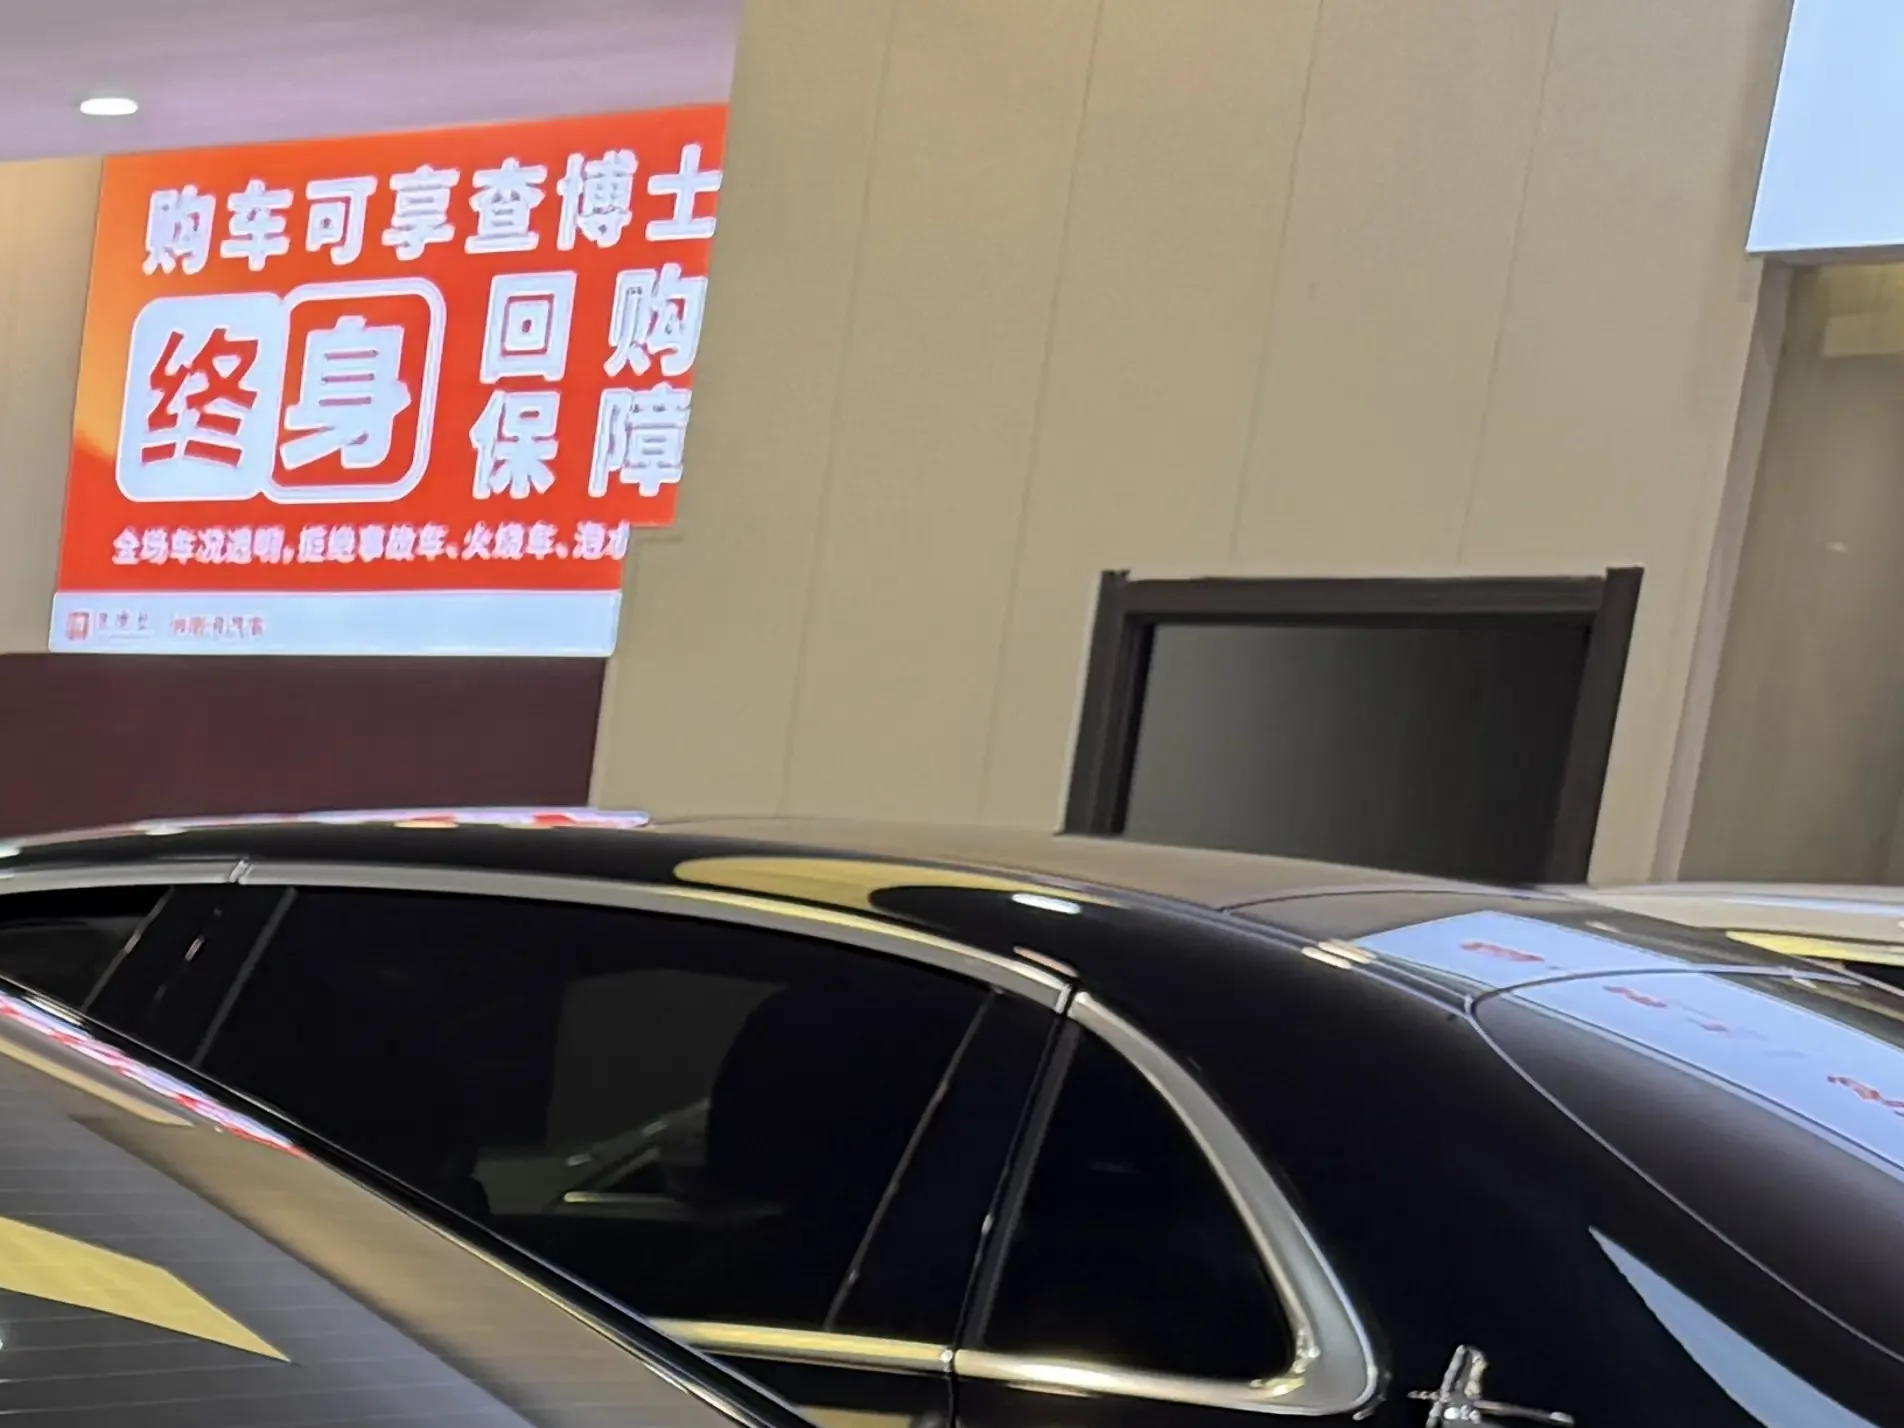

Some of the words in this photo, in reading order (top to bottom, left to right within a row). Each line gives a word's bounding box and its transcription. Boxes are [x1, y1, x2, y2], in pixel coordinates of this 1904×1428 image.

[143, 144, 726, 275] 购车可享查博士
[479, 262, 709, 385] 回购
[140, 315, 413, 473] 终身
[469, 384, 693, 500] 保障
